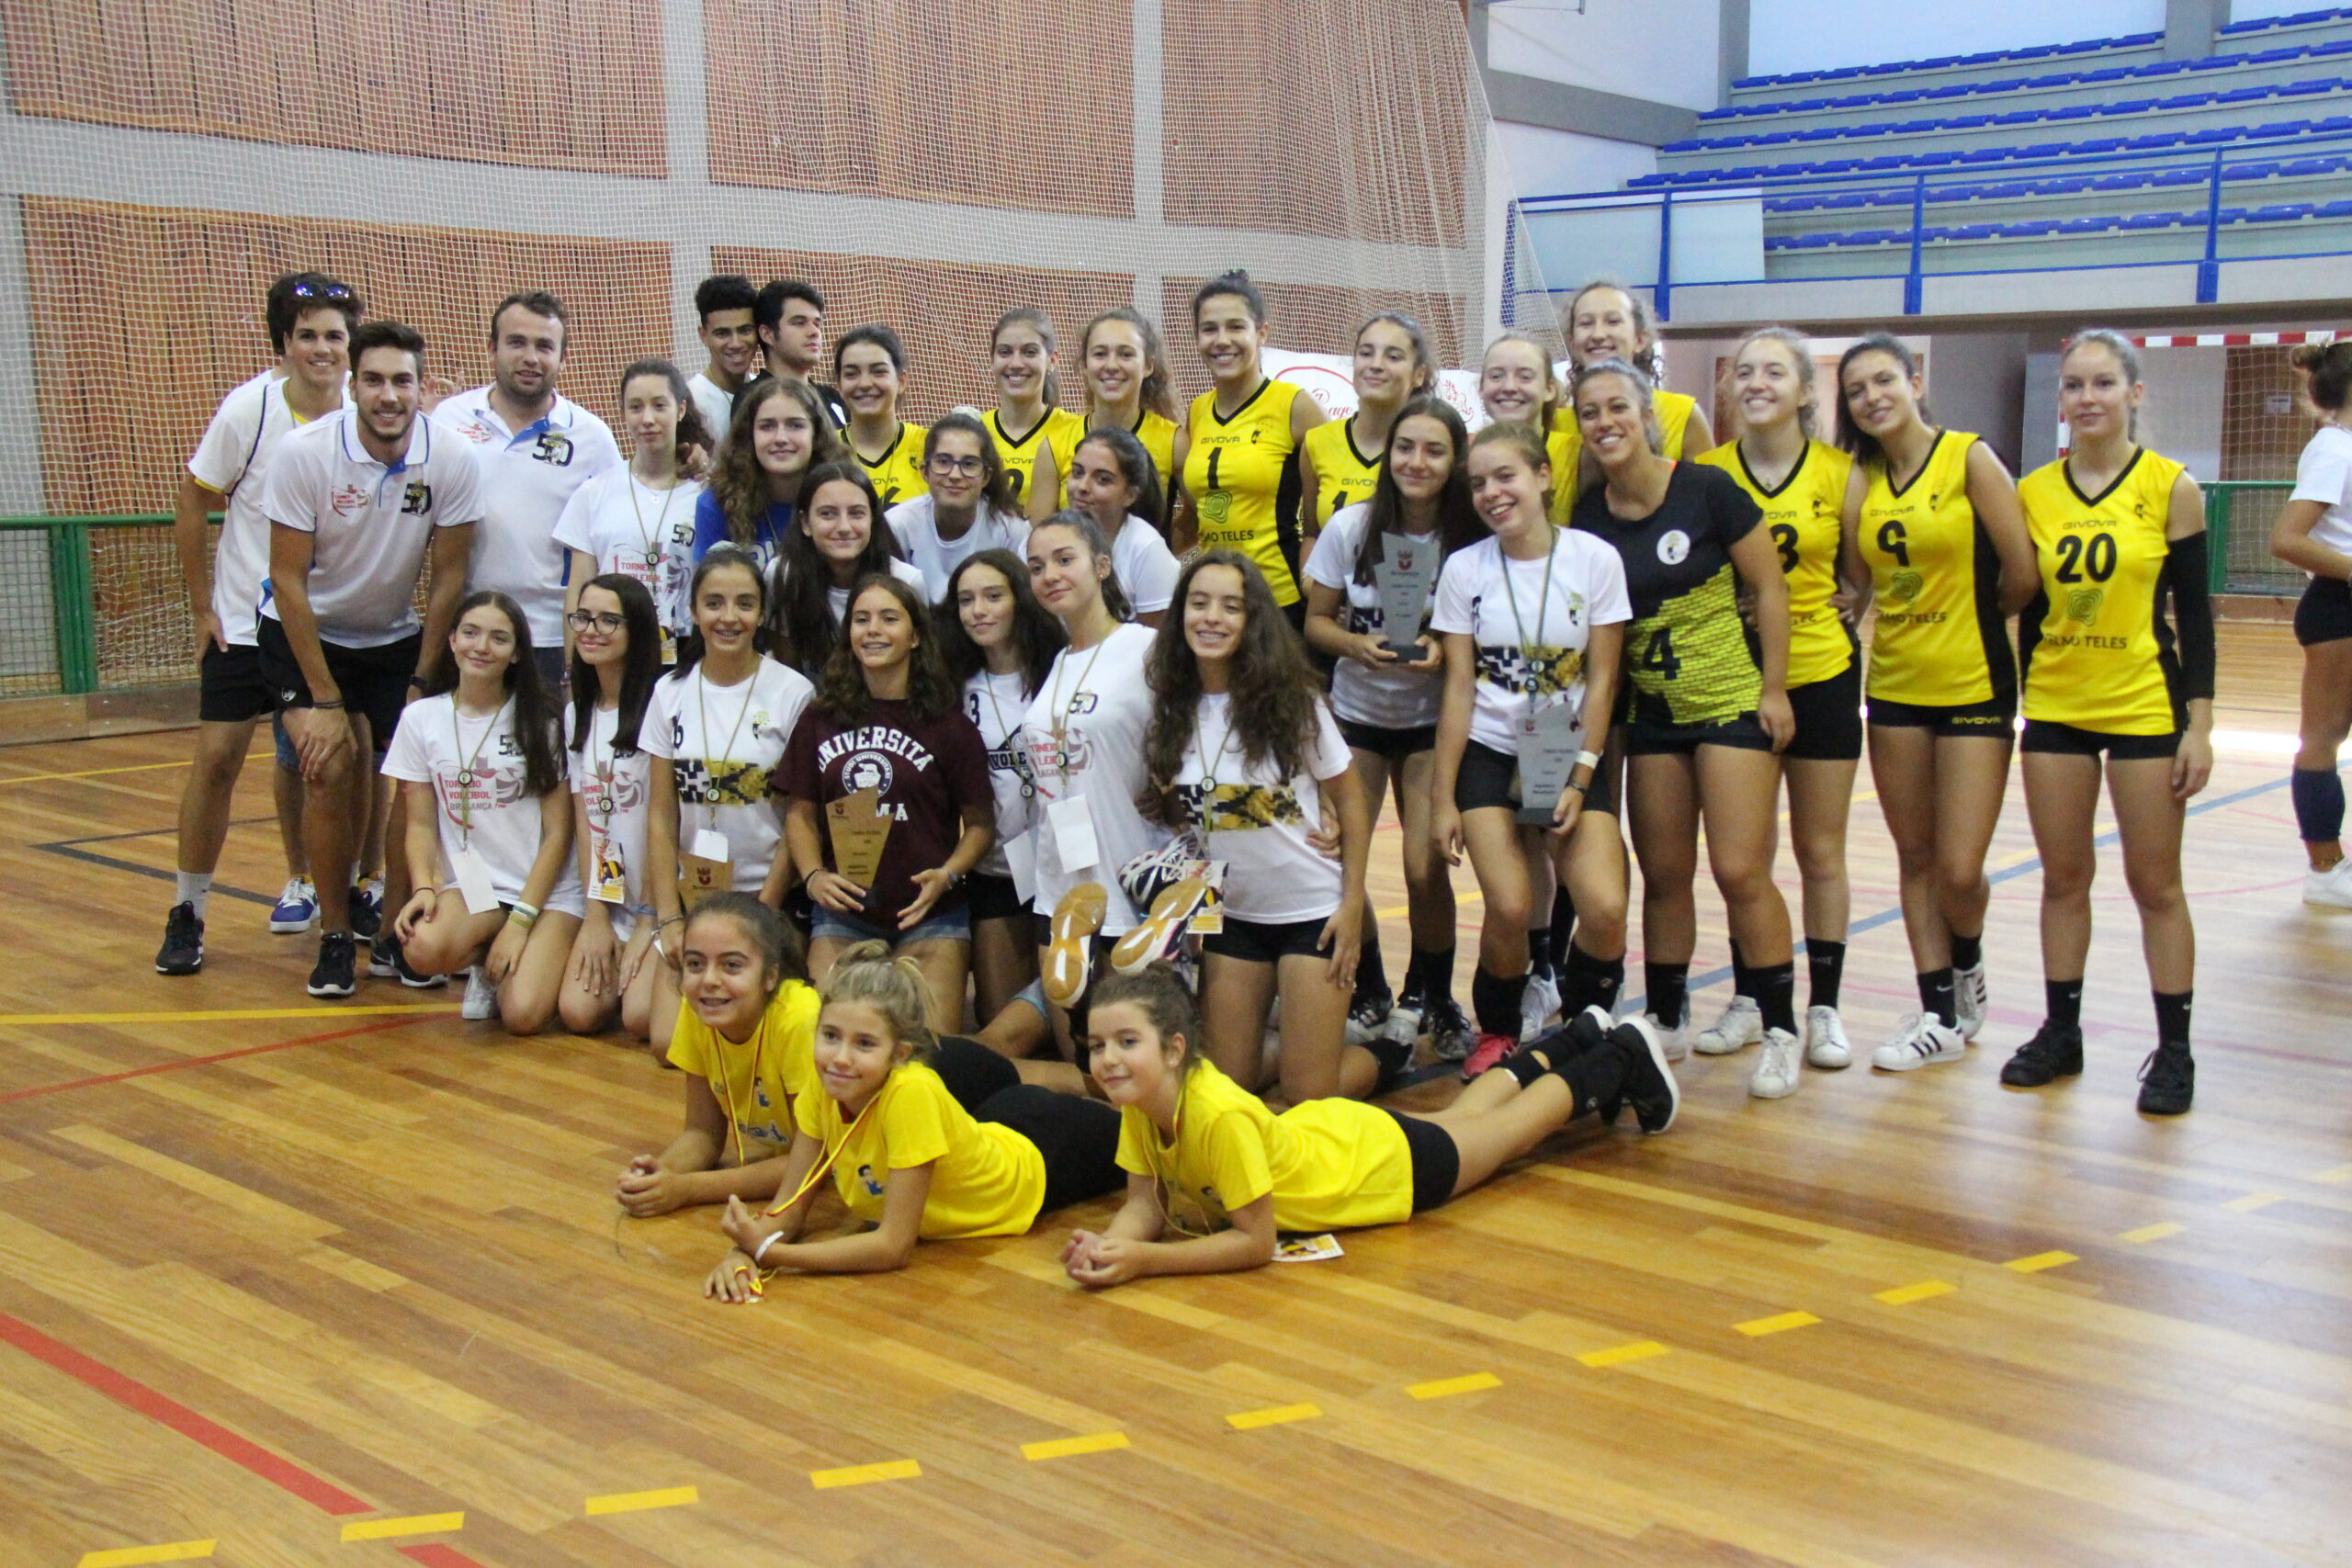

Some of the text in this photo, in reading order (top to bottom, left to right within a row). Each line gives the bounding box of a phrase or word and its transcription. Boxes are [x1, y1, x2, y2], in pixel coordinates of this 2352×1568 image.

[1201, 435, 1240, 445] GIVOVA
[1207, 446, 1222, 490] 1
[1341, 478, 1377, 487] GIVO
[1870, 505, 1916, 517] GIVOVA
[2062, 520, 2117, 530] GIVOVA
[1220, 530, 1254, 542] TELES
[2055, 532, 2117, 584] 20
[2085, 636, 2128, 649] TELES
[1643, 627, 1681, 681] 4
[1951, 716, 2002, 726] GIVOVA
[875, 803, 909, 821] MA
